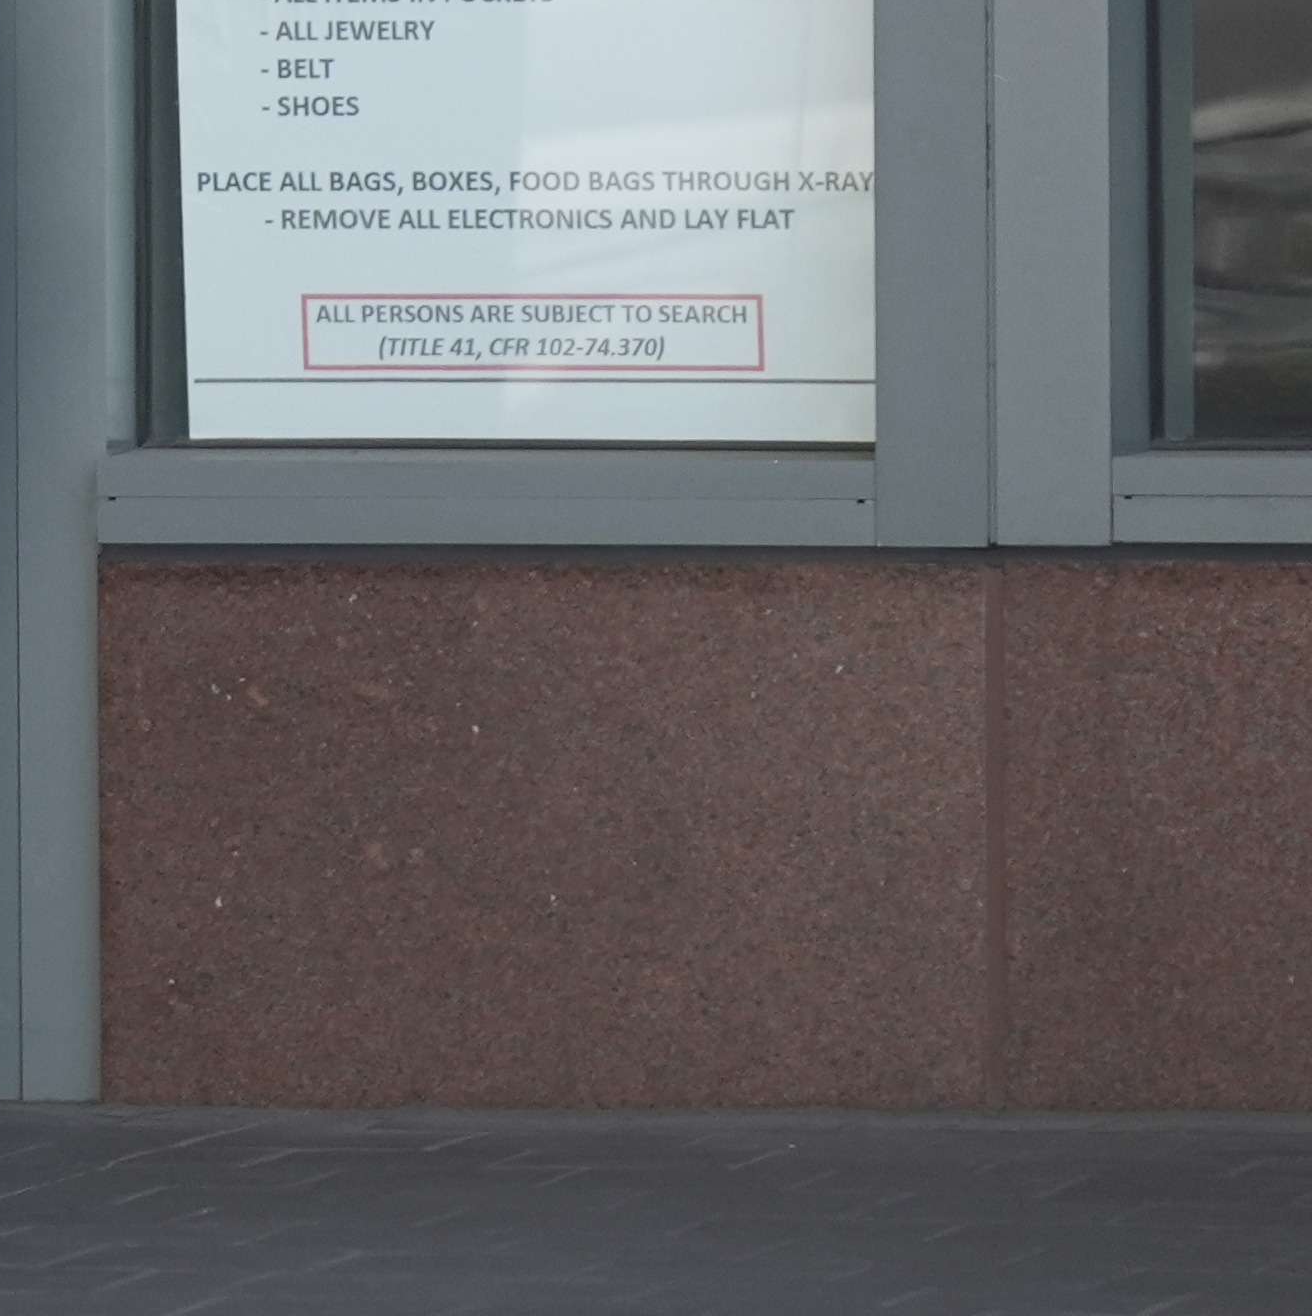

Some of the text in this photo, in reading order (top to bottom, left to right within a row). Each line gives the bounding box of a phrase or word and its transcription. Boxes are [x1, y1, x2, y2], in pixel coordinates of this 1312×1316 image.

[276, 21, 318, 41] ALL
[325, 21, 435, 40] JEWELRY
[278, 59, 334, 78] BELT
[278, 96, 359, 116] SHOES
[198, 171, 875, 196] PLACE ALL BAGS, BOXES, FOOD BAGS THROUGH X-RAY
[282, 209, 391, 229] REMOVE
[398, 209, 440, 229] ALL
[448, 209, 612, 229] ELECTRONICS
[620, 209, 676, 229] AND
[685, 209, 729, 229] LAY
[737, 209, 795, 229] FLAT
[316, 305, 747, 323] ALL PERSONS ARE SUBJECT TO SEARCH
[379, 336, 664, 361] (TITLE 41, CFR 102-74.370)
